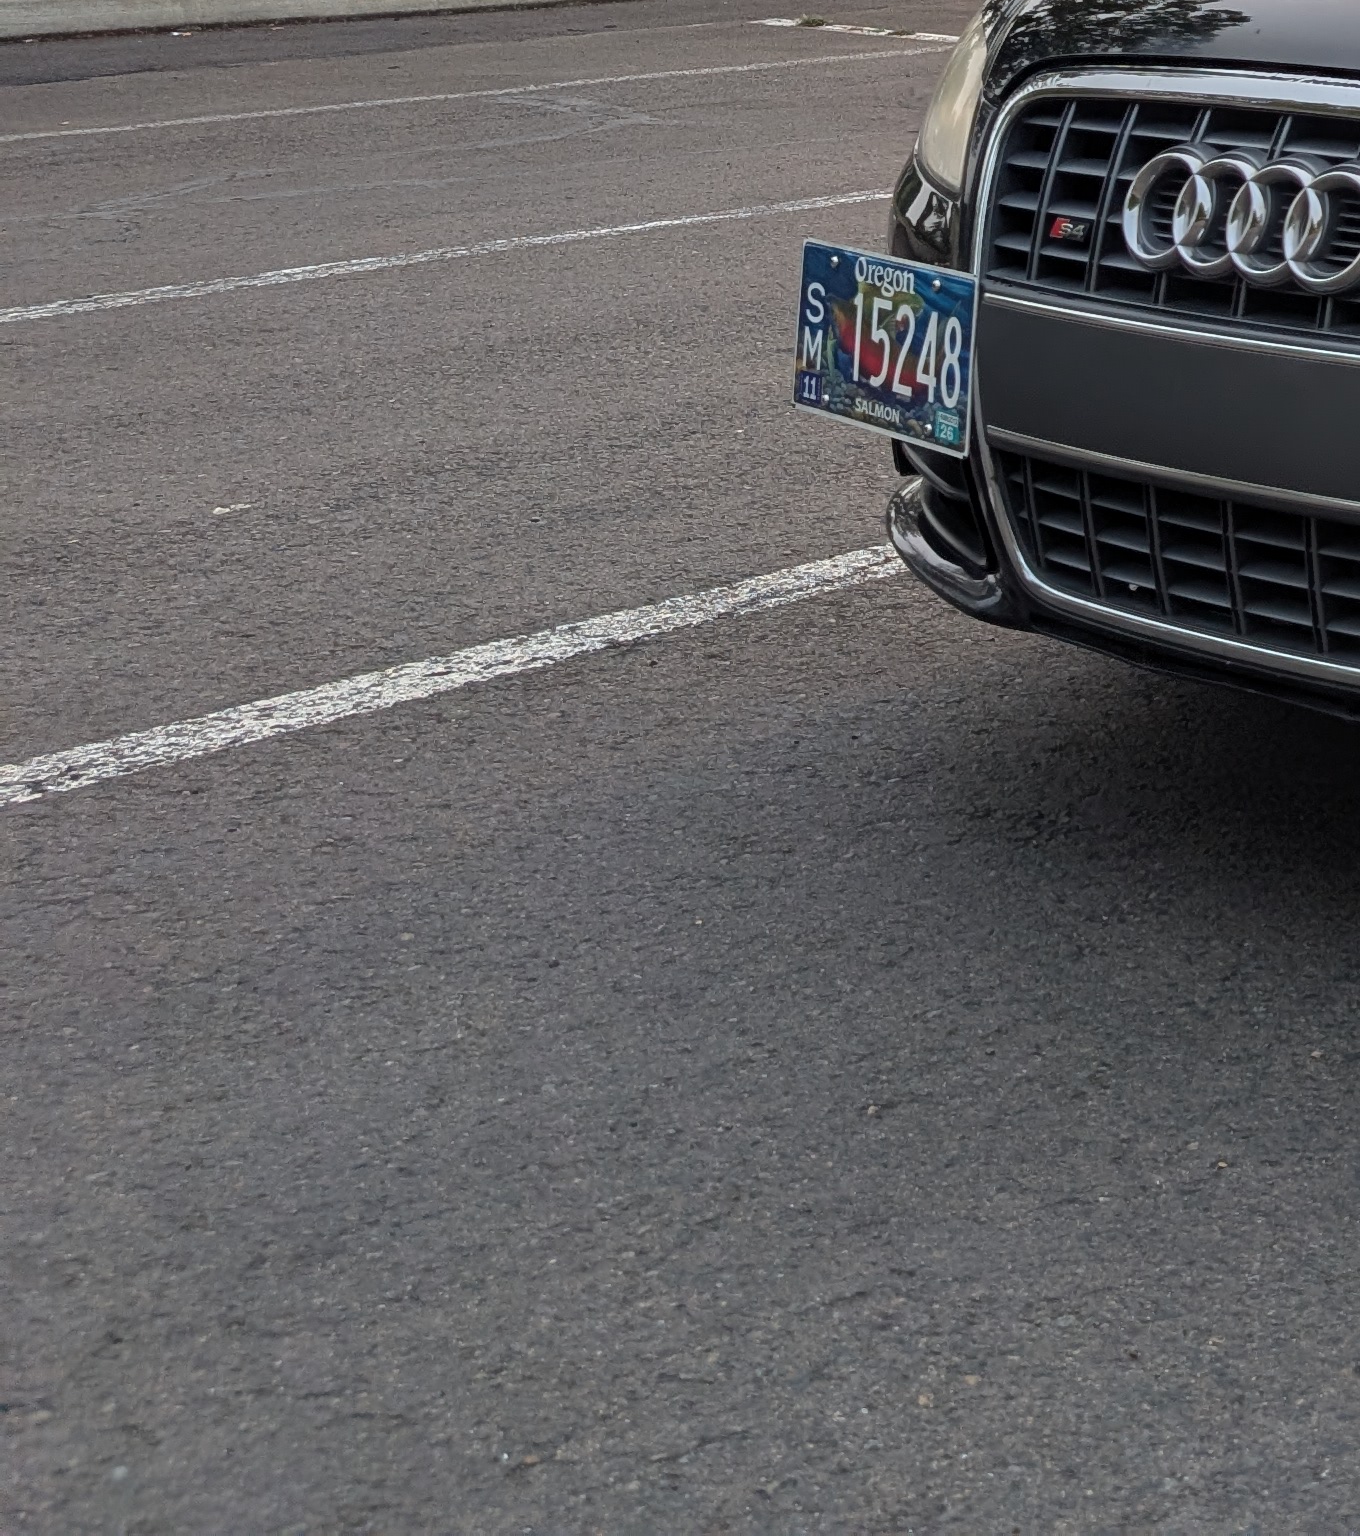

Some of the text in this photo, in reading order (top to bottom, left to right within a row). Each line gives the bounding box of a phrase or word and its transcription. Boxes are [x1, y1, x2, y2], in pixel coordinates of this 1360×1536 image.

[1058, 222, 1085, 238] S4
[854, 256, 915, 297] Oregon
[852, 292, 963, 408] 15248
[803, 375, 818, 401] 11
[853, 397, 900, 424] SALMON
[940, 423, 954, 441] 26
